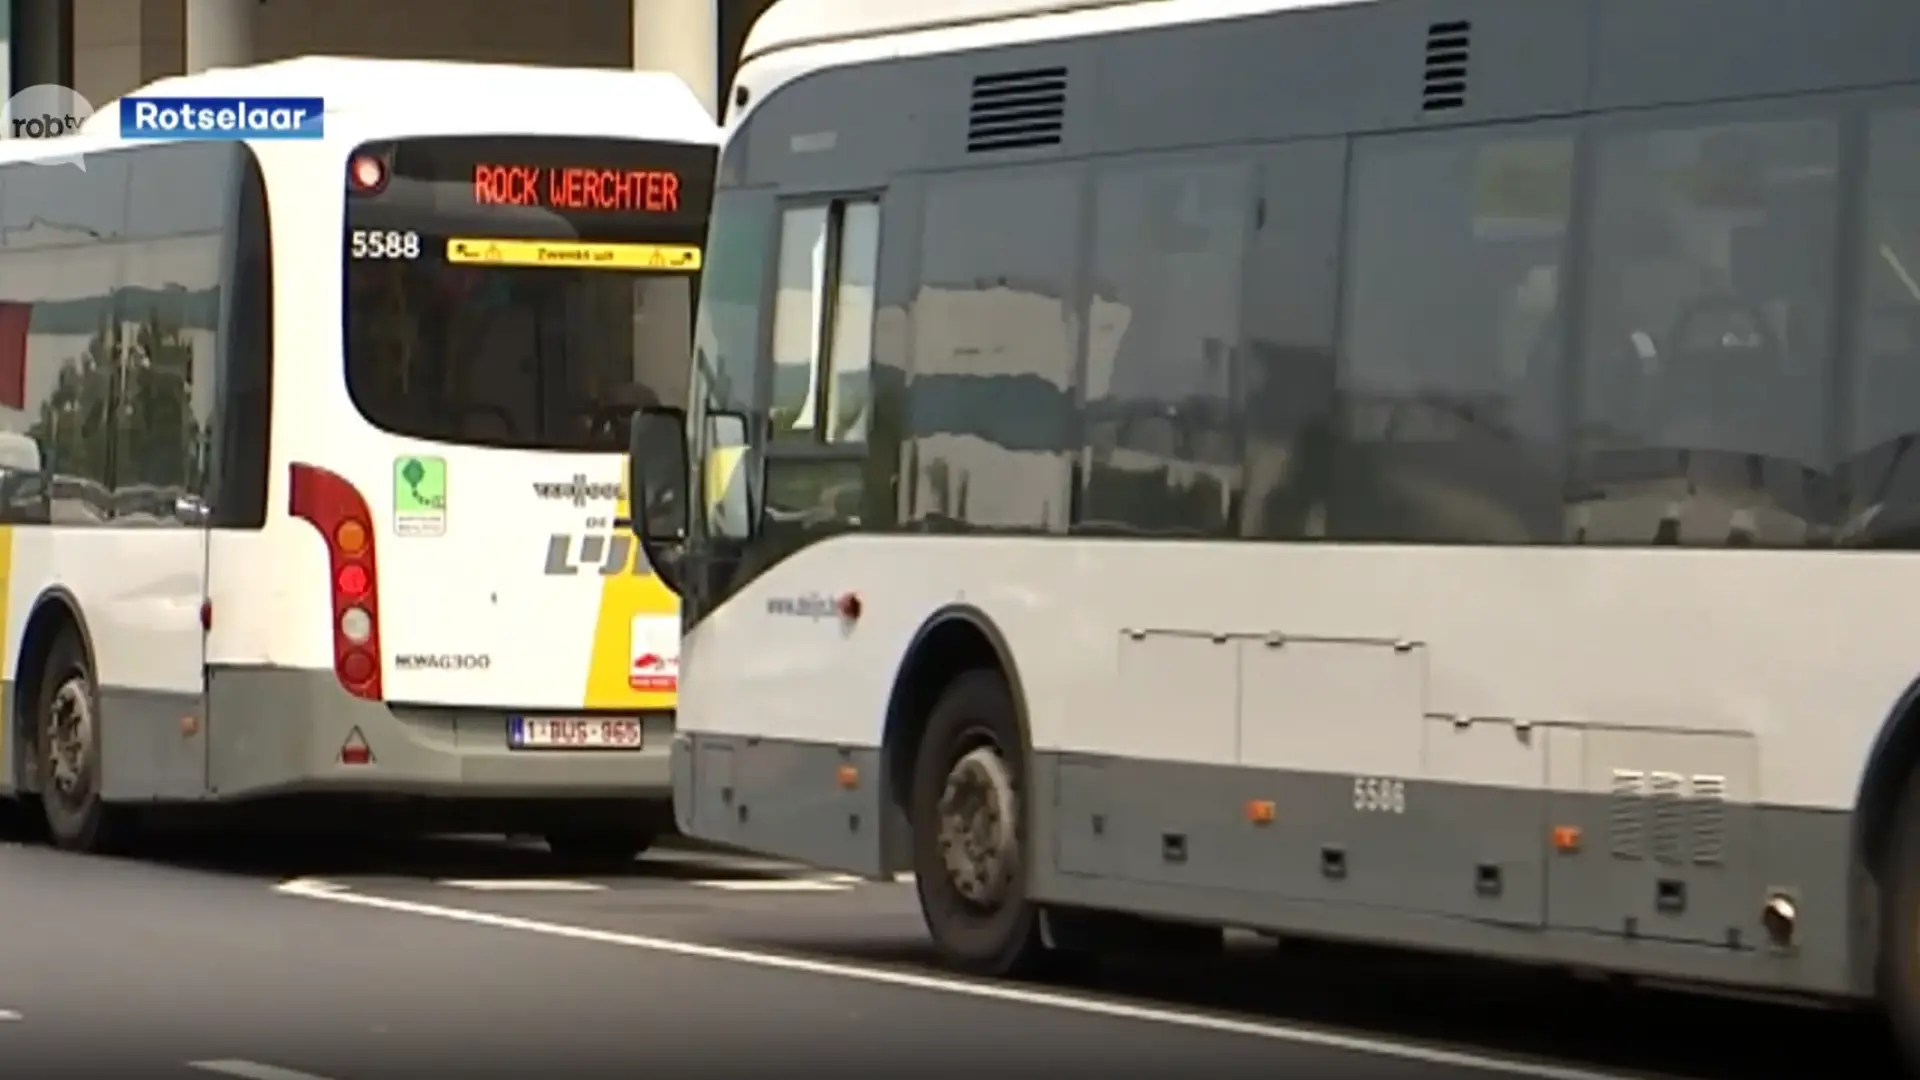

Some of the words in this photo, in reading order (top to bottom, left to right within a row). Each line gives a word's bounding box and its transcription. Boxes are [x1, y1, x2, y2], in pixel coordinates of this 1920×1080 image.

[475, 165, 539, 205] ROCK
[550, 168, 679, 211] WERCHTER
[352, 230, 420, 258] 5588
